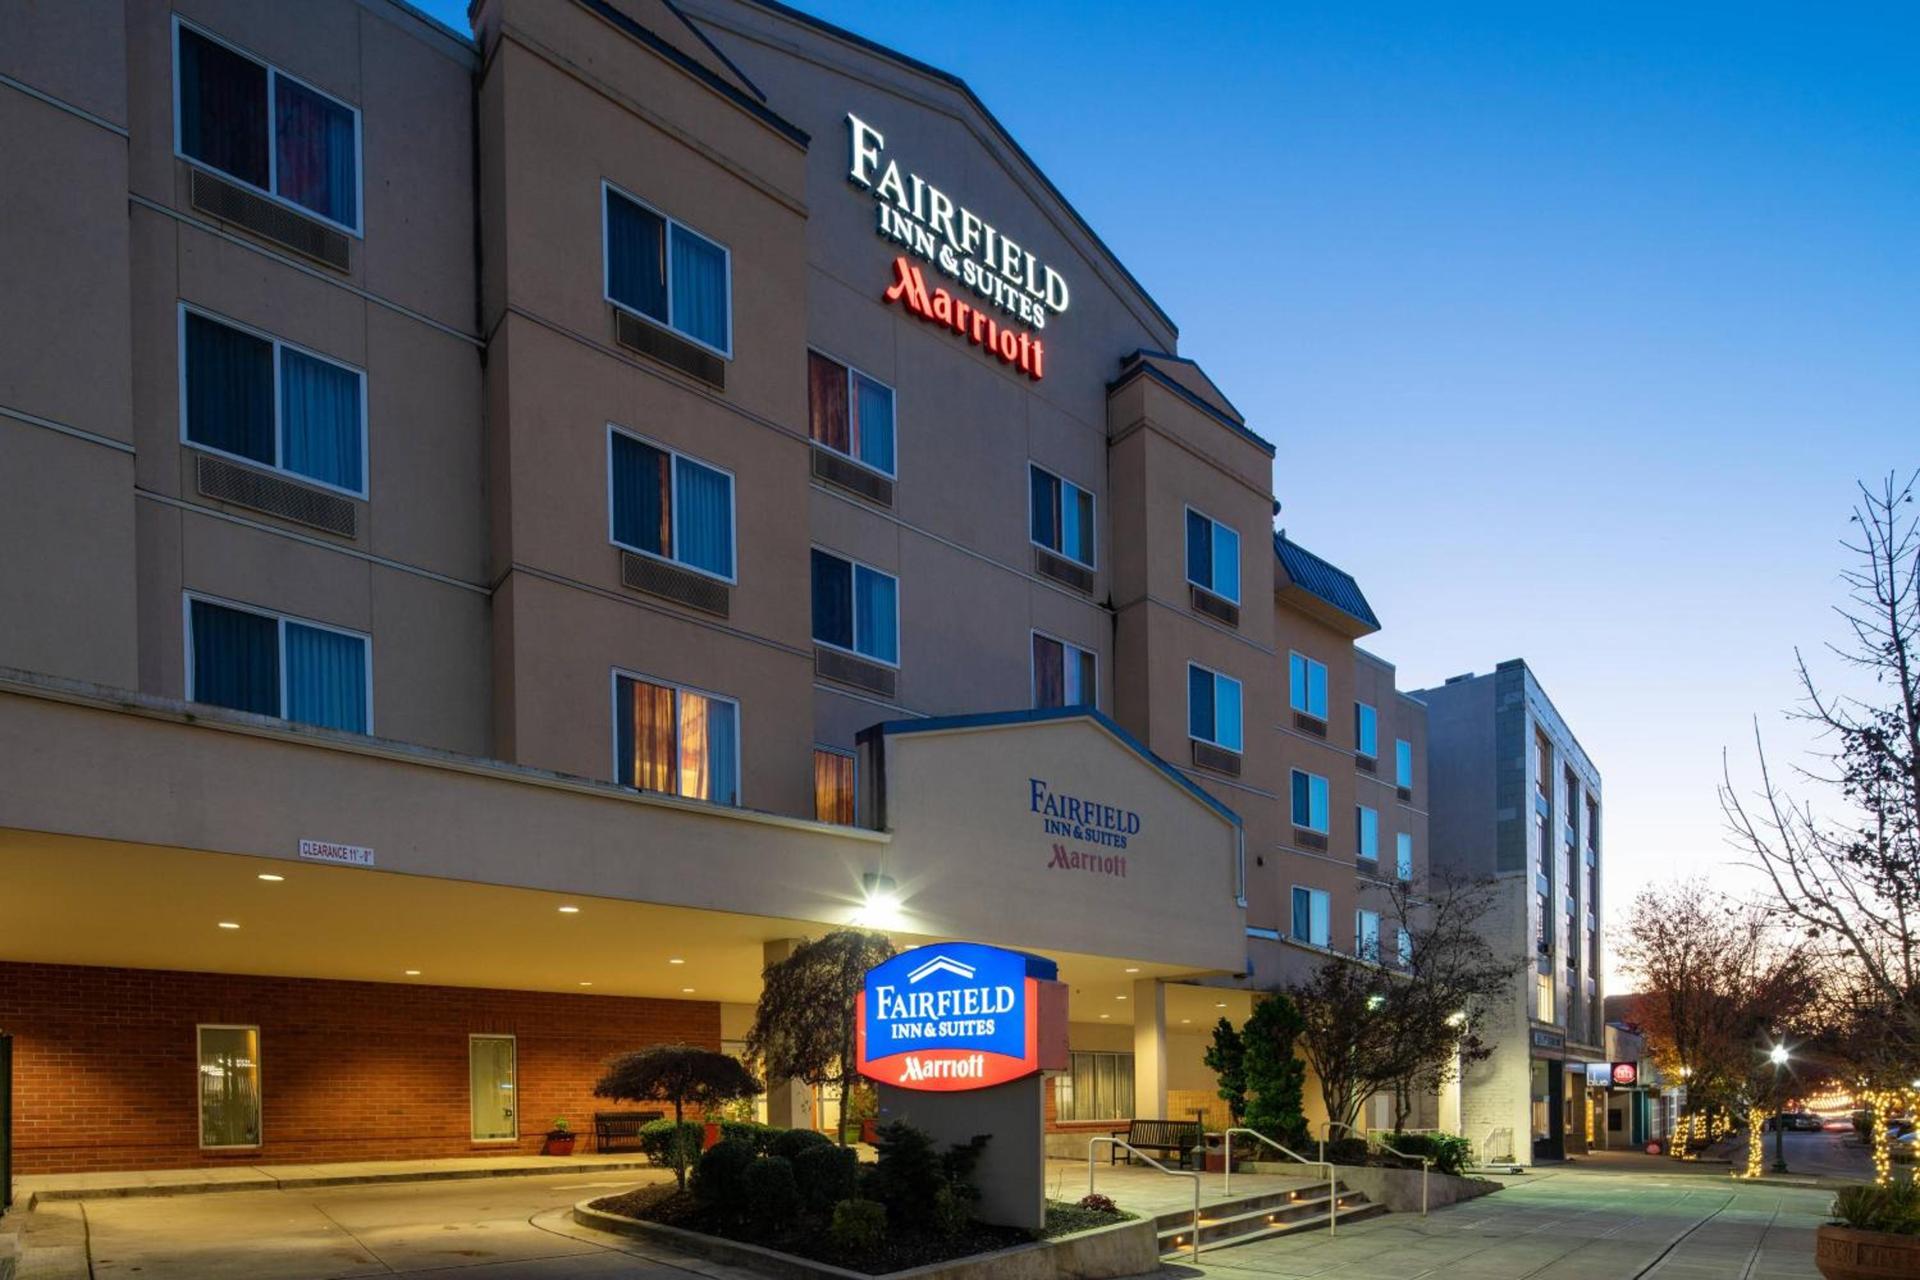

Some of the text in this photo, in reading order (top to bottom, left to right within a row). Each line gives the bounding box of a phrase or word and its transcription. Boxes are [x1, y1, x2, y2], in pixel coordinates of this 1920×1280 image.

[847, 112, 1069, 313] FAIRFIELD
[879, 202, 1045, 329] INN & SUITES
[885, 256, 1043, 378] Marriott
[1029, 778, 1140, 835] FAIRFIELD
[302, 842, 347, 859] CLEARANCE
[1044, 818, 1127, 849] INN & SUITES
[1048, 843, 1126, 878] Marriott
[876, 986, 1015, 1020] FAIRFIELD
[891, 1019, 995, 1039] INN & SUITES
[900, 1055, 984, 1082] Marriott
